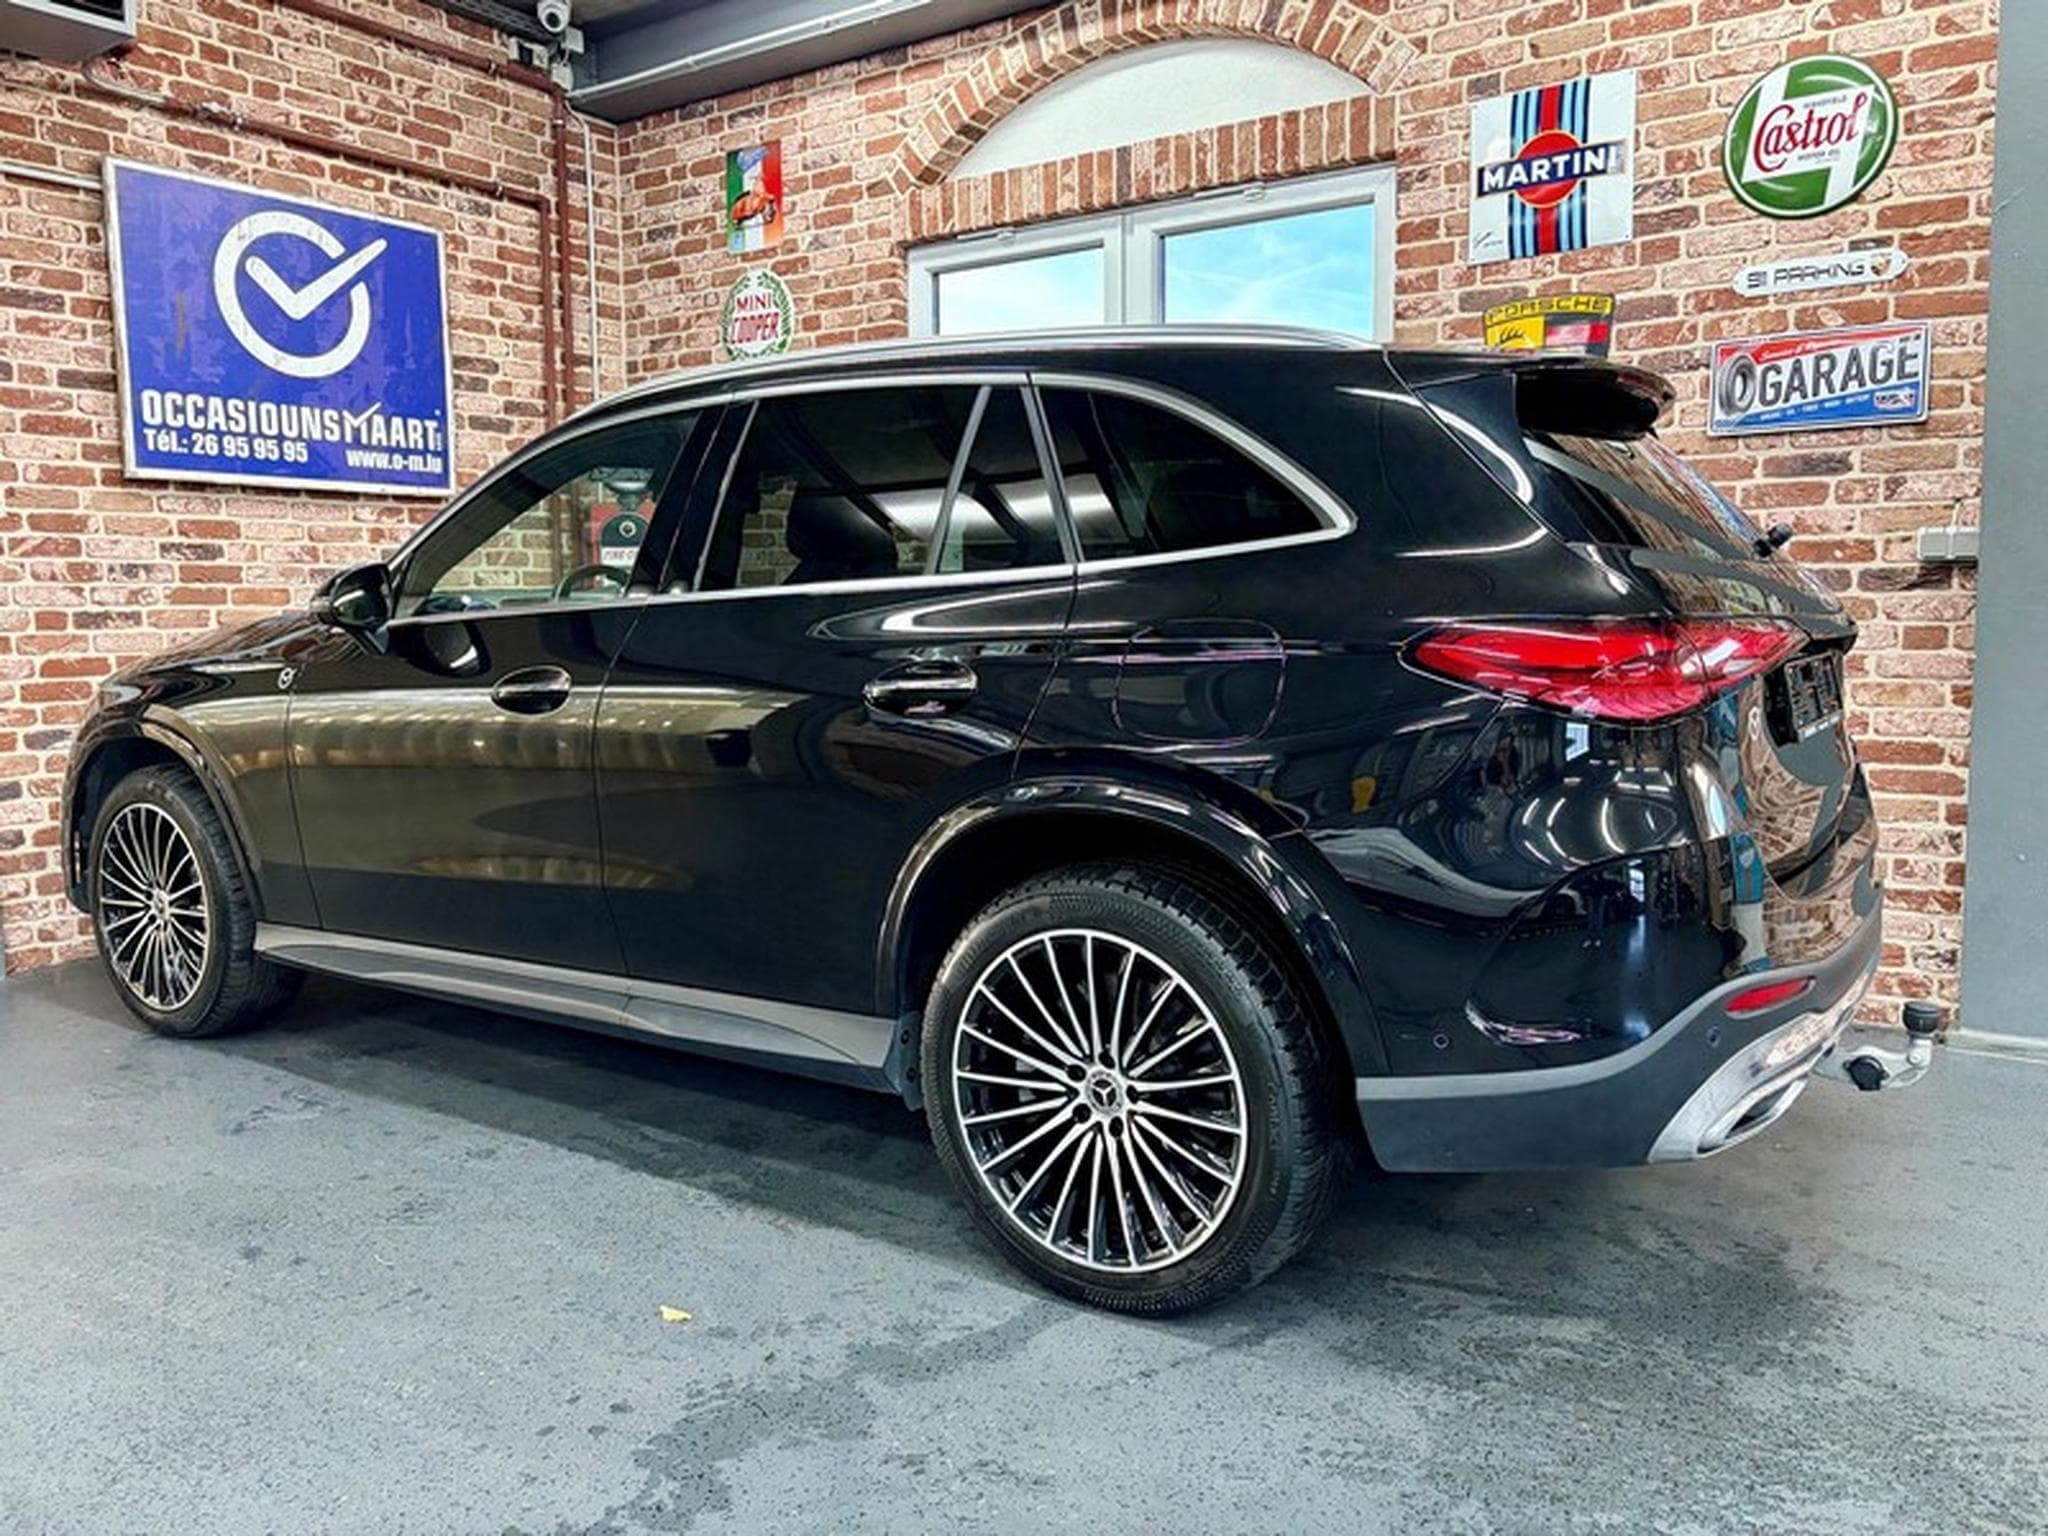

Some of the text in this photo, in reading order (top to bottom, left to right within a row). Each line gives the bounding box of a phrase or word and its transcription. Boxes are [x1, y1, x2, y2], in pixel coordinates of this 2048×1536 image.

[1753, 91, 1869, 173] Castrol
[1481, 145, 1617, 193] MARTINI
[1773, 260, 1865, 284] PARKING
[736, 292, 771, 313] MINI
[1488, 297, 1609, 322] PORSCHE
[731, 312, 779, 344] COOPER
[192, 431, 218, 456] 26
[222, 434, 249, 458] 95
[253, 437, 279, 460] 95
[283, 440, 308, 463] 95
